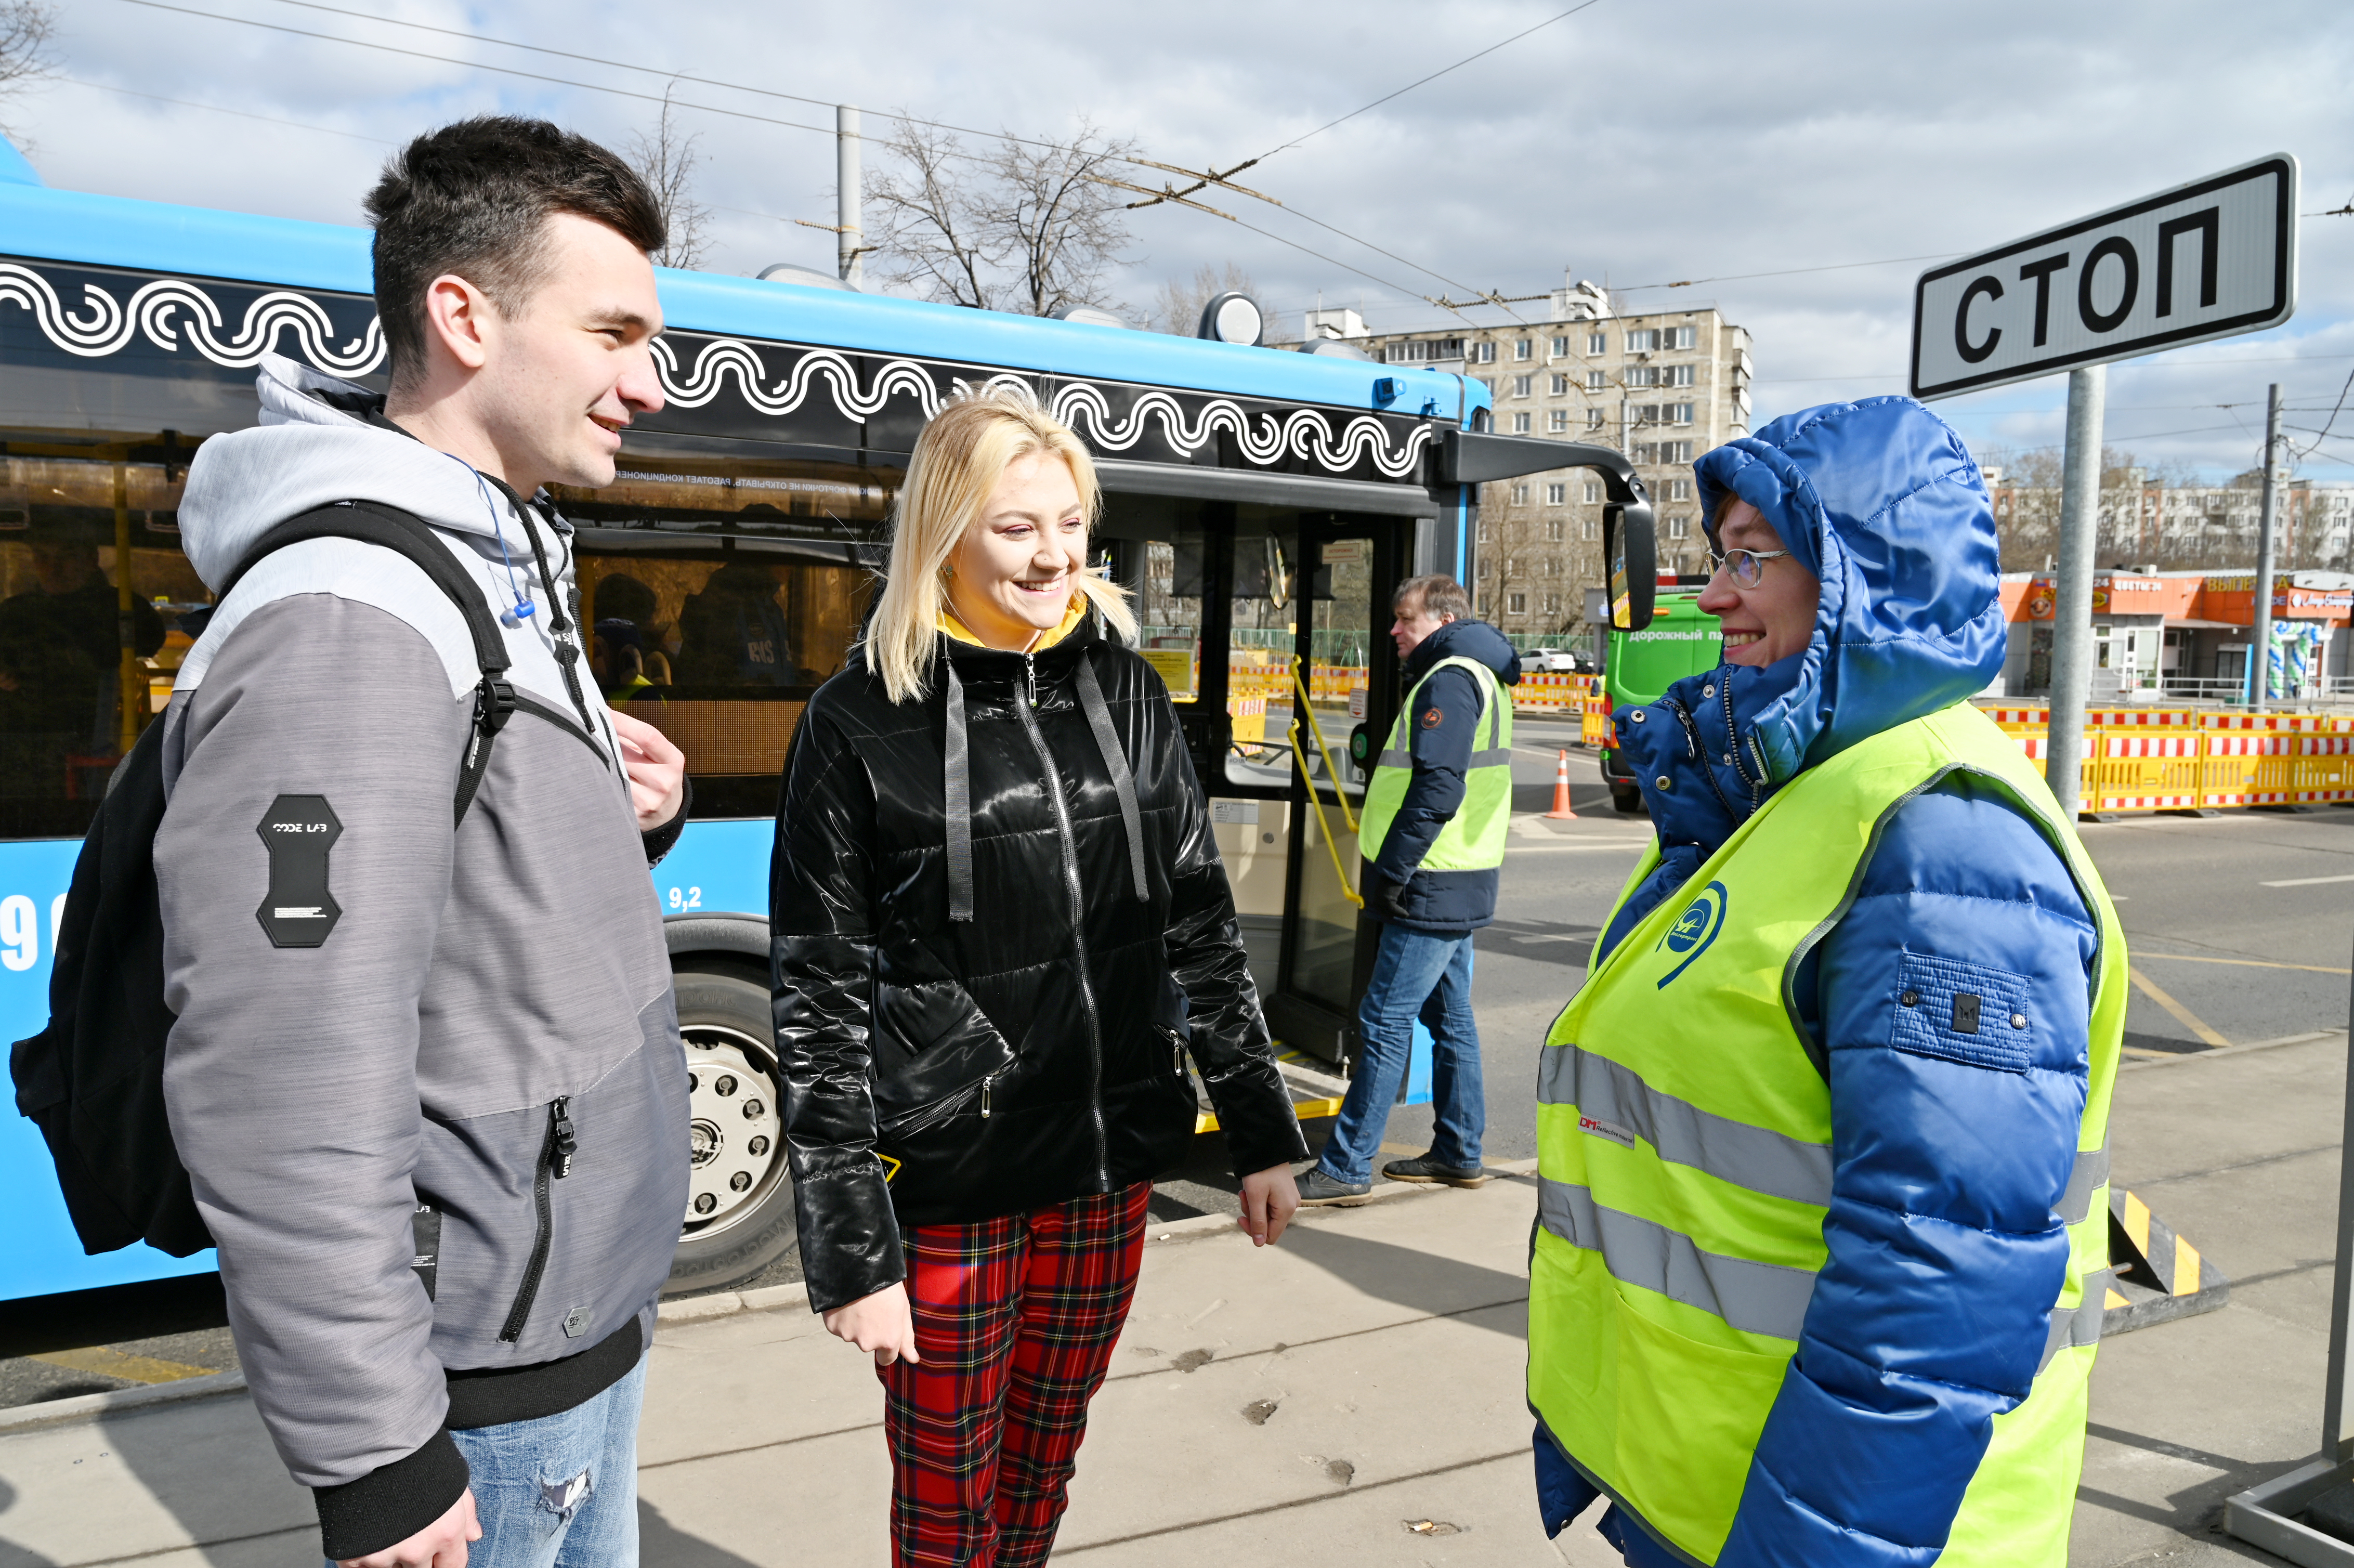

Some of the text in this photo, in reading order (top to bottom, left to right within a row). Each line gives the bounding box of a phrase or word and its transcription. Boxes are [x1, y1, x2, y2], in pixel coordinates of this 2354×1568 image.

[1955, 205, 2219, 363] СТОП
[2207, 576, 2288, 592] ВЫПЕА
[1629, 629, 1703, 643] Дорожный
[307, 824, 327, 832] LAB
[669, 886, 701, 912] 9,2
[1596, 1126, 1619, 1137] Reflective
